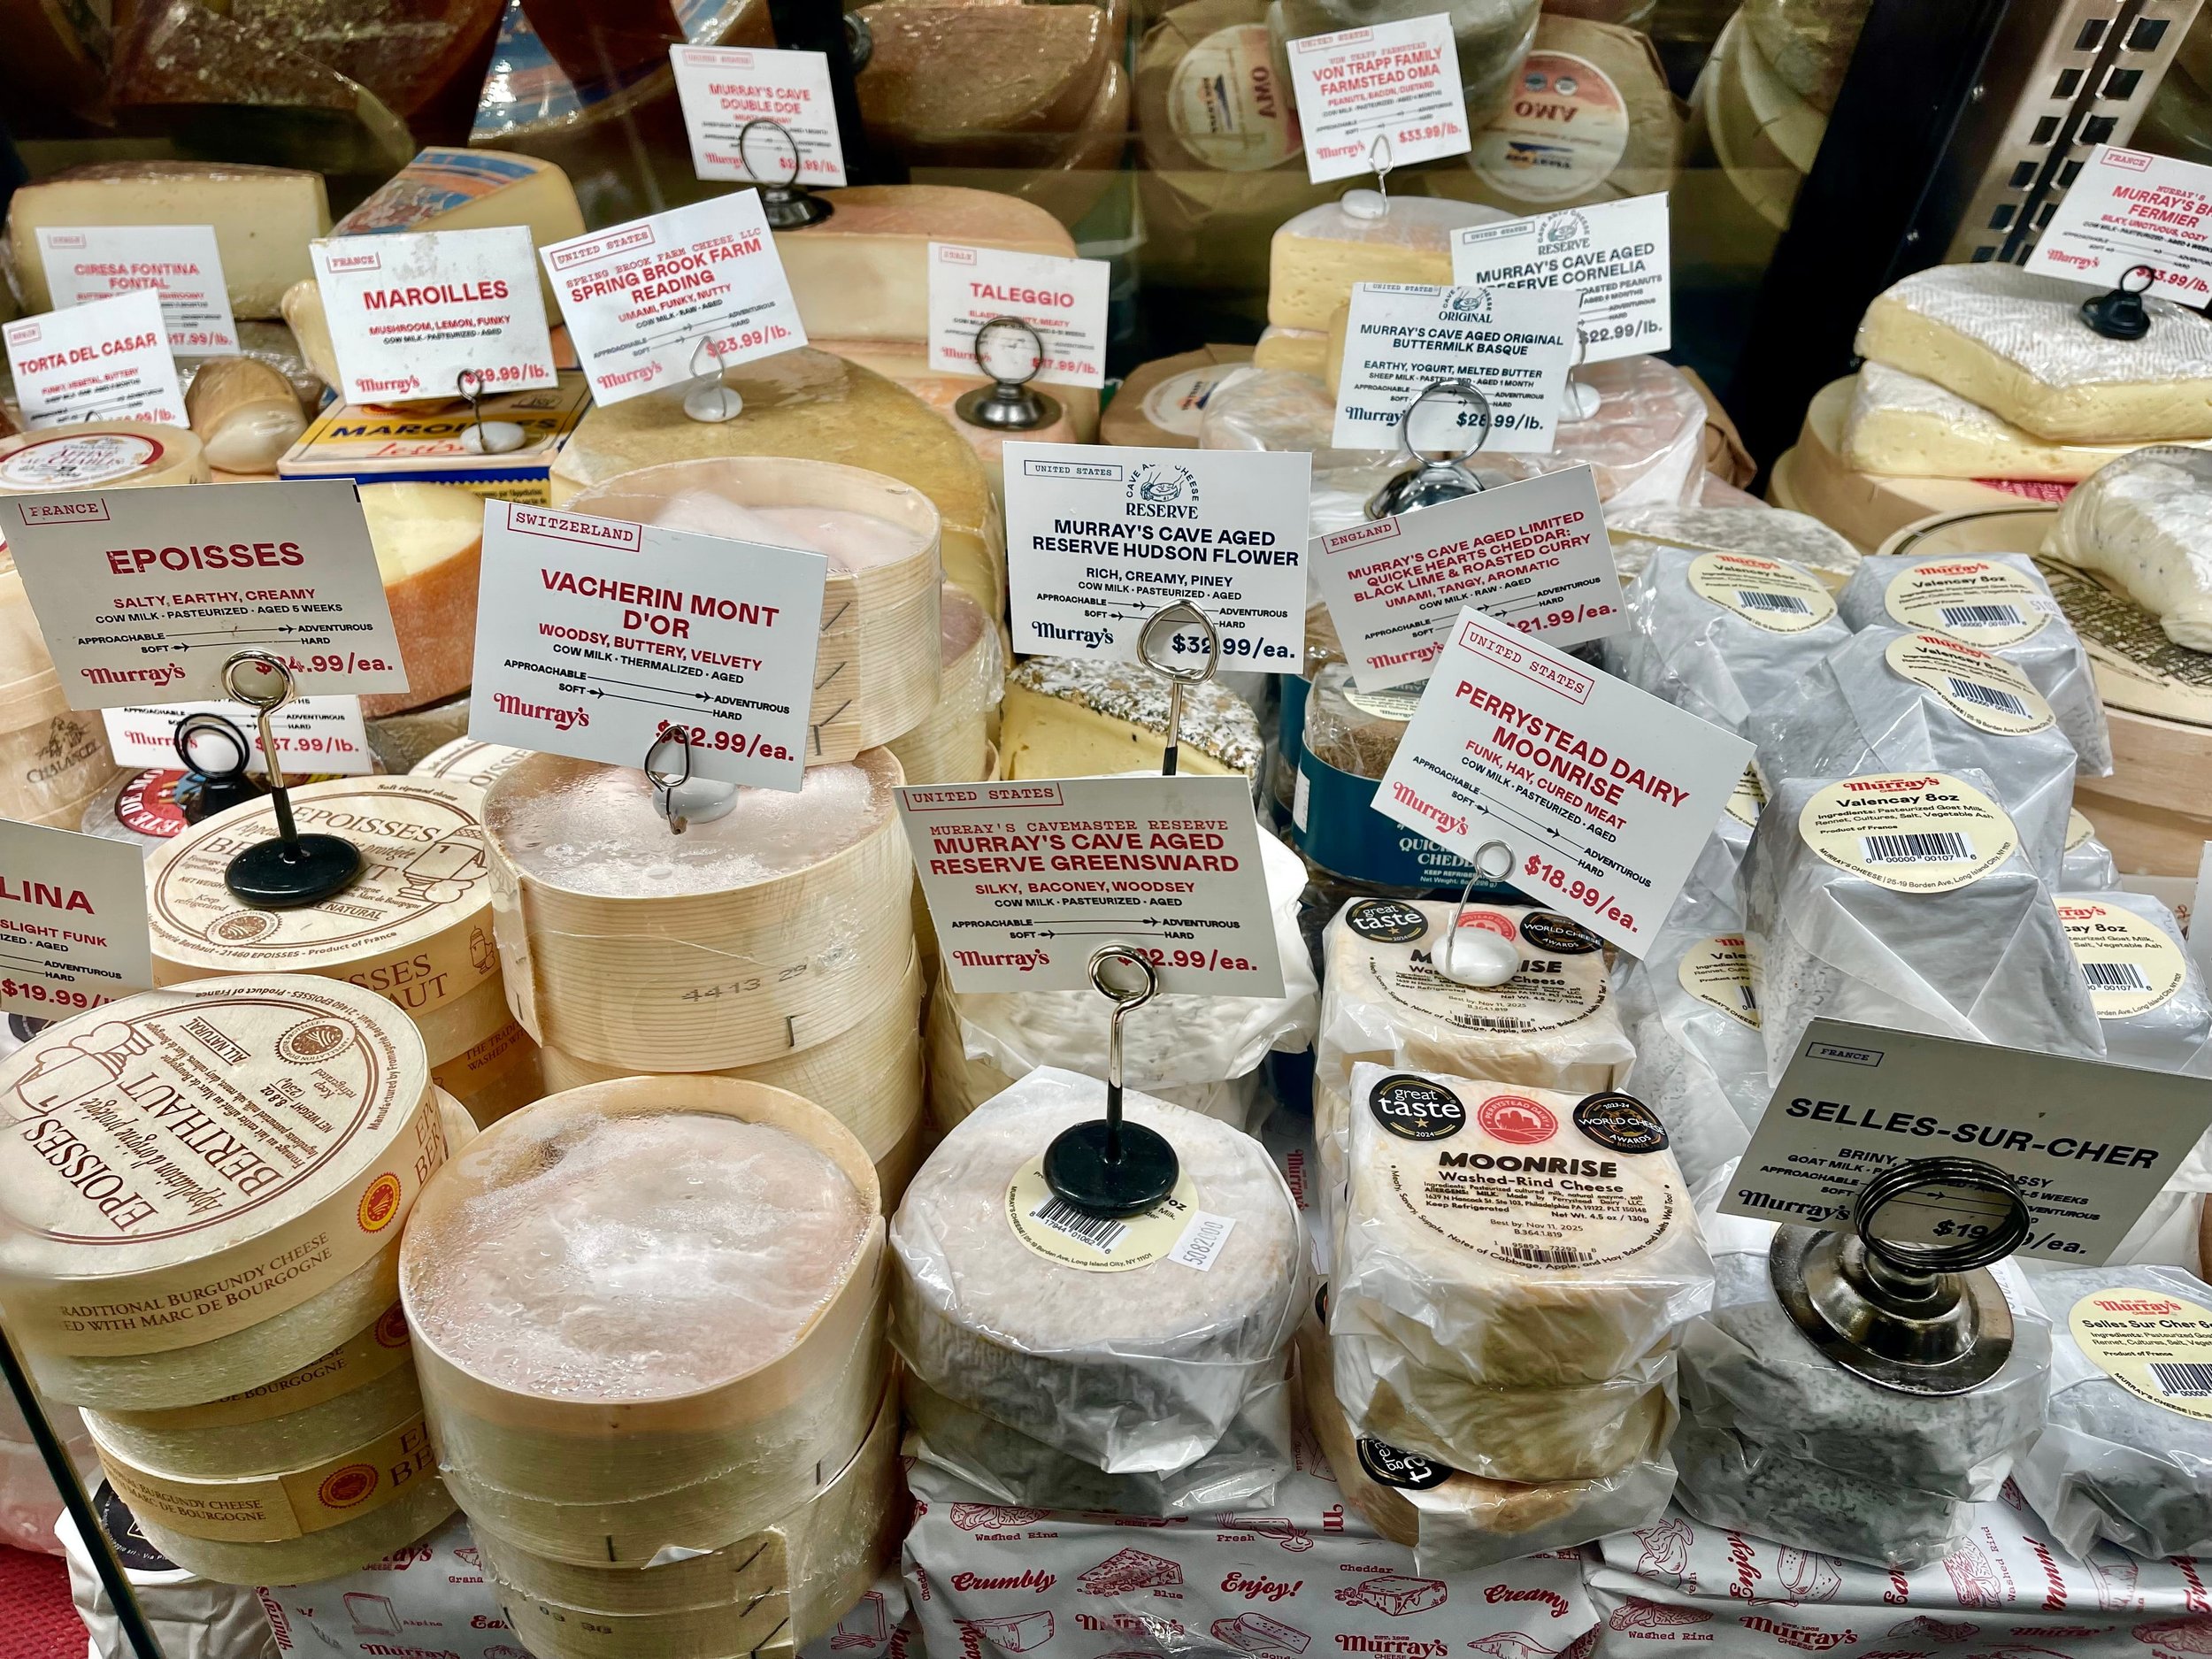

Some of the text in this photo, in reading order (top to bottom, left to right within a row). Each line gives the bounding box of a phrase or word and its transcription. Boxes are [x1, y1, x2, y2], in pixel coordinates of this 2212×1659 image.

[1313, 66, 1344, 81] VON
[1347, 57, 1392, 74] TRAPP
[1394, 46, 1442, 66] FAMILY
[709, 83, 810, 101] MURRAY'S CAVE
[1320, 64, 1440, 96] FARMSTEAD OMA
[721, 99, 802, 113] DOUBLE DOE
[2108, 153, 2146, 166] FRANCE
[2128, 204, 2200, 228] FERMIER
[557, 232, 649, 265] UNITED STATES
[691, 235, 734, 252] CHEESE
[740, 227, 761, 240] LLC
[1538, 237, 1590, 256] RESERVE
[74, 263, 200, 276] CIRESA FONTINA
[572, 239, 763, 303] SPRING BROOK FARM
[1476, 243, 1655, 284] MURRAY'S CAVE AGED
[1562, 260, 1646, 283] CORNELIA
[109, 276, 170, 289] FONTAL
[363, 280, 510, 311] MAROILLES
[631, 269, 715, 303] READING
[970, 282, 1075, 308] TALEGGIO
[618, 283, 732, 323] UMAMI, FUNKY, NUTTY
[369, 315, 511, 335] MUSHROOM, LEMON, FUNKY
[1361, 324, 1563, 346] MURRAY'S CAVE AGED ORIGINAL
[706, 325, 791, 357] $23.99/lb.
[1393, 339, 1528, 356] BUTTERMILK BASQUE
[18, 333, 157, 376] TORTA DEL CASAR
[1364, 360, 1542, 379] EARTHY, YOGURT, MELTED BUTTER
[356, 375, 420, 393] Murray's
[28, 503, 99, 517] FRANCE
[1125, 503, 1199, 519] RESERVE
[516, 512, 634, 542] SWITZERLAND
[1054, 518, 1276, 547] MURRAY'S CAVE AGED
[1330, 523, 1392, 547] ENGLAND
[105, 541, 304, 575] EPOISSES
[1033, 536, 1299, 566] RESERVE HUDSON FLOWER
[1348, 511, 1586, 580] MURRAY'S CAVE AGED LIMITED
[1366, 528, 1571, 587] QUICKE HEARTS CHEDDAR:
[1086, 567, 1233, 588] RICH, CREAMY, PINEY
[1353, 534, 1591, 603] BLACK LIME & ROASTED CURRY
[1386, 557, 1561, 609] UMAMI, TANGY, AROMATIC
[113, 588, 316, 609] SALTY, EARTHY, CREAMY
[541, 569, 780, 627] VACHERIN MONT
[166, 608, 249, 620] PASTEURIZED
[623, 610, 690, 639] D'OR
[77, 623, 373, 645] APPROACHABLE ADVENTUROUS
[538, 624, 763, 671] WOODSY, BUTTERY, VELVETY
[620, 655, 703, 678] THERMALIZED
[1469, 631, 1586, 695] UNITED STATES
[493, 693, 590, 730] Murray's
[1454, 680, 1690, 809] PERRYSTEAD DAIRY
[1492, 726, 1626, 807] MOONRISE
[1465, 741, 1627, 831] FUNK, HAY, CURED MEAT
[1843, 777, 1939, 792] Murray's
[1817, 810, 1876, 819] Ingredients:
[1836, 795, 1920, 808] Valencay
[291, 806, 440, 842] EPOISSES
[930, 820, 1229, 835] MURRAY'S CAVEMASTER RESERVE
[933, 833, 1225, 855] MURRAY'S CAVE AGED
[929, 856, 1239, 874] RESERVE GREENSWARD
[975, 882, 1195, 895] SILKY, BACONEY, WOODSEY
[1523, 854, 1639, 933] $18.99/ea.
[63, 931, 108, 947] FUNK
[186, 1018, 248, 1064] ALL NATURAL
[1820, 1048, 1870, 1062] FRANCE
[1379, 1097, 1461, 1118] taste
[1395, 1089, 1438, 1102] great
[117, 1071, 286, 1197] BERTHAUT
[1786, 1097, 2160, 1170] SELLES-SUR-CHER
[23, 1119, 158, 1233] EPOISSES
[1439, 1152, 1617, 1178] MOONRISE
[1439, 1171, 1624, 1193] Washed-Rind Cheese
[1452, 1203, 1509, 1213] Refrigerated
[168, 1232, 330, 1308] BURGUNDY CHEESE
[88, 1248, 333, 1332] WITH MARC DE BOURGOGNE
[951, 1570, 1056, 1592] Crumbly
[1340, 1564, 1393, 1573] Cheddar
[1220, 1571, 1303, 1601] Enjoy!
[1484, 1584, 1569, 1617] Creamy
[1739, 1616, 1857, 1651] Murray's
